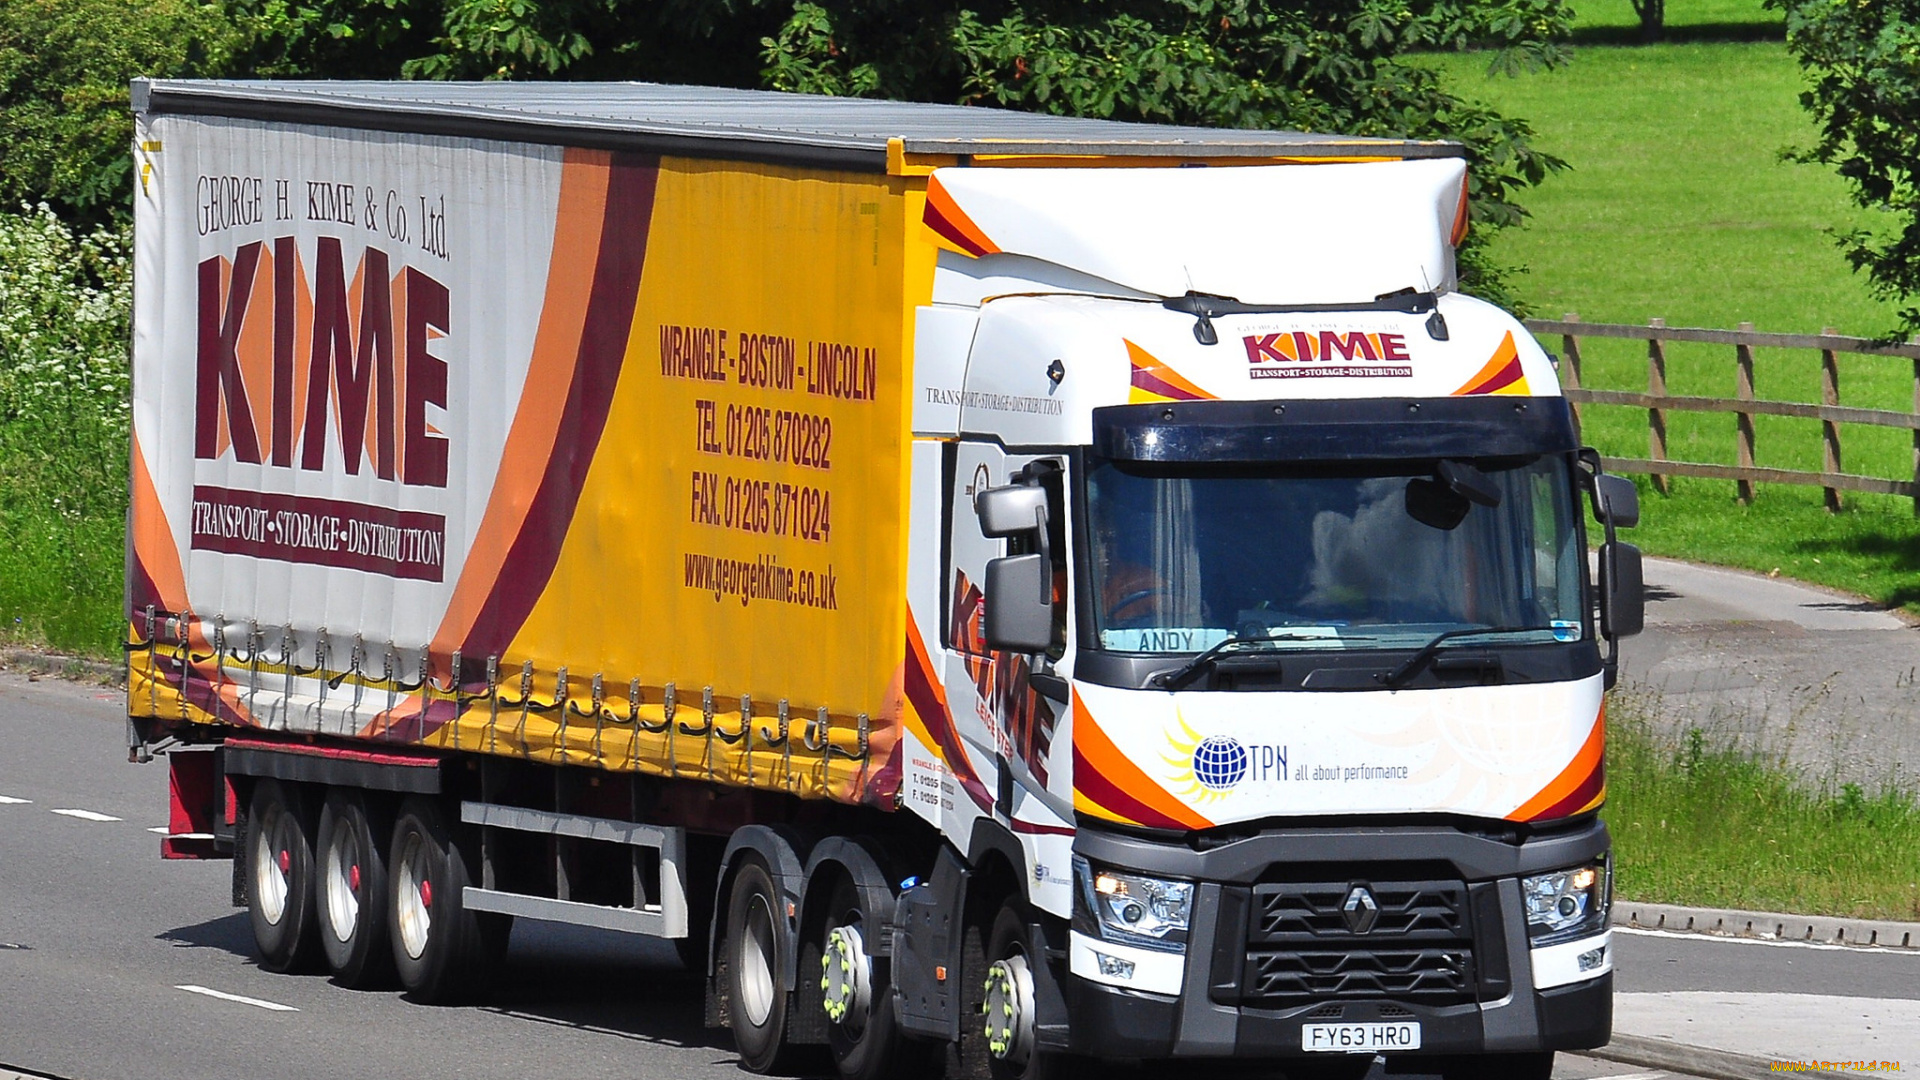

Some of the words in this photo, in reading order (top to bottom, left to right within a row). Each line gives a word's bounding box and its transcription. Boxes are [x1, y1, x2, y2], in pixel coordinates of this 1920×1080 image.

[197, 175, 263, 236] GEORGE
[276, 180, 294, 220] H.
[307, 181, 355, 226] KIME
[364, 186, 378, 231] &
[386, 190, 411, 244] Co.
[420, 195, 450, 261] Ltd.
[195, 236, 450, 488] KIME
[659, 324, 727, 382] WRANGLE
[738, 332, 795, 390] BOSTON
[807, 341, 877, 401] LINCOLN
[1242, 330, 1412, 363] KIME
[695, 400, 722, 454] TEL.
[725, 403, 770, 461] 01205
[774, 410, 832, 469] 870282
[691, 471, 720, 525] FAX.
[724, 476, 770, 534] 01205
[773, 484, 831, 543] 871024
[684, 553, 838, 610] www.georgehkime.co.uk
[1139, 632, 1194, 651] ANDY
[1249, 745, 1288, 781] TPN
[1294, 764, 1309, 781] all
[1312, 764, 1340, 781] about
[1344, 763, 1408, 783] performance
[1312, 1027, 1365, 1046] FY63
